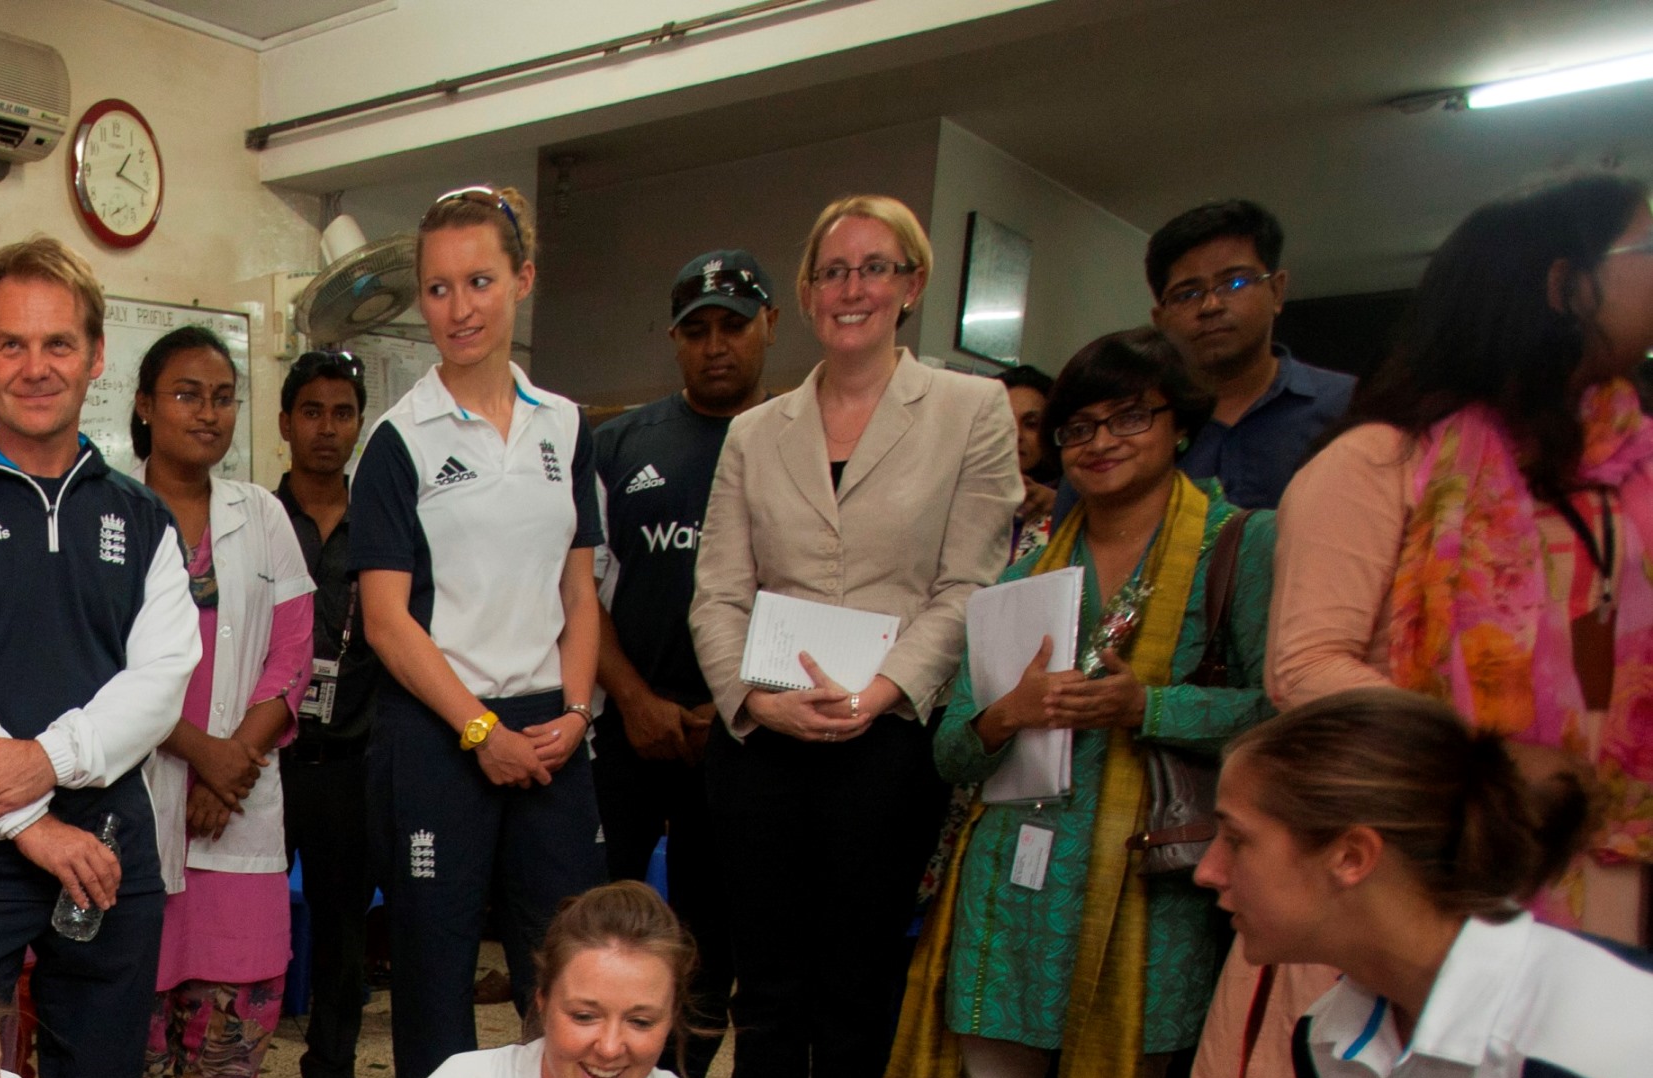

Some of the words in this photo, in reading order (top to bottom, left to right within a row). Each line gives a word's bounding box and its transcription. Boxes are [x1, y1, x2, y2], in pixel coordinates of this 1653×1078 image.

[136, 307, 174, 327] PROFILE
[626, 477, 666, 495] adidas
[640, 520, 703, 553] Wai
